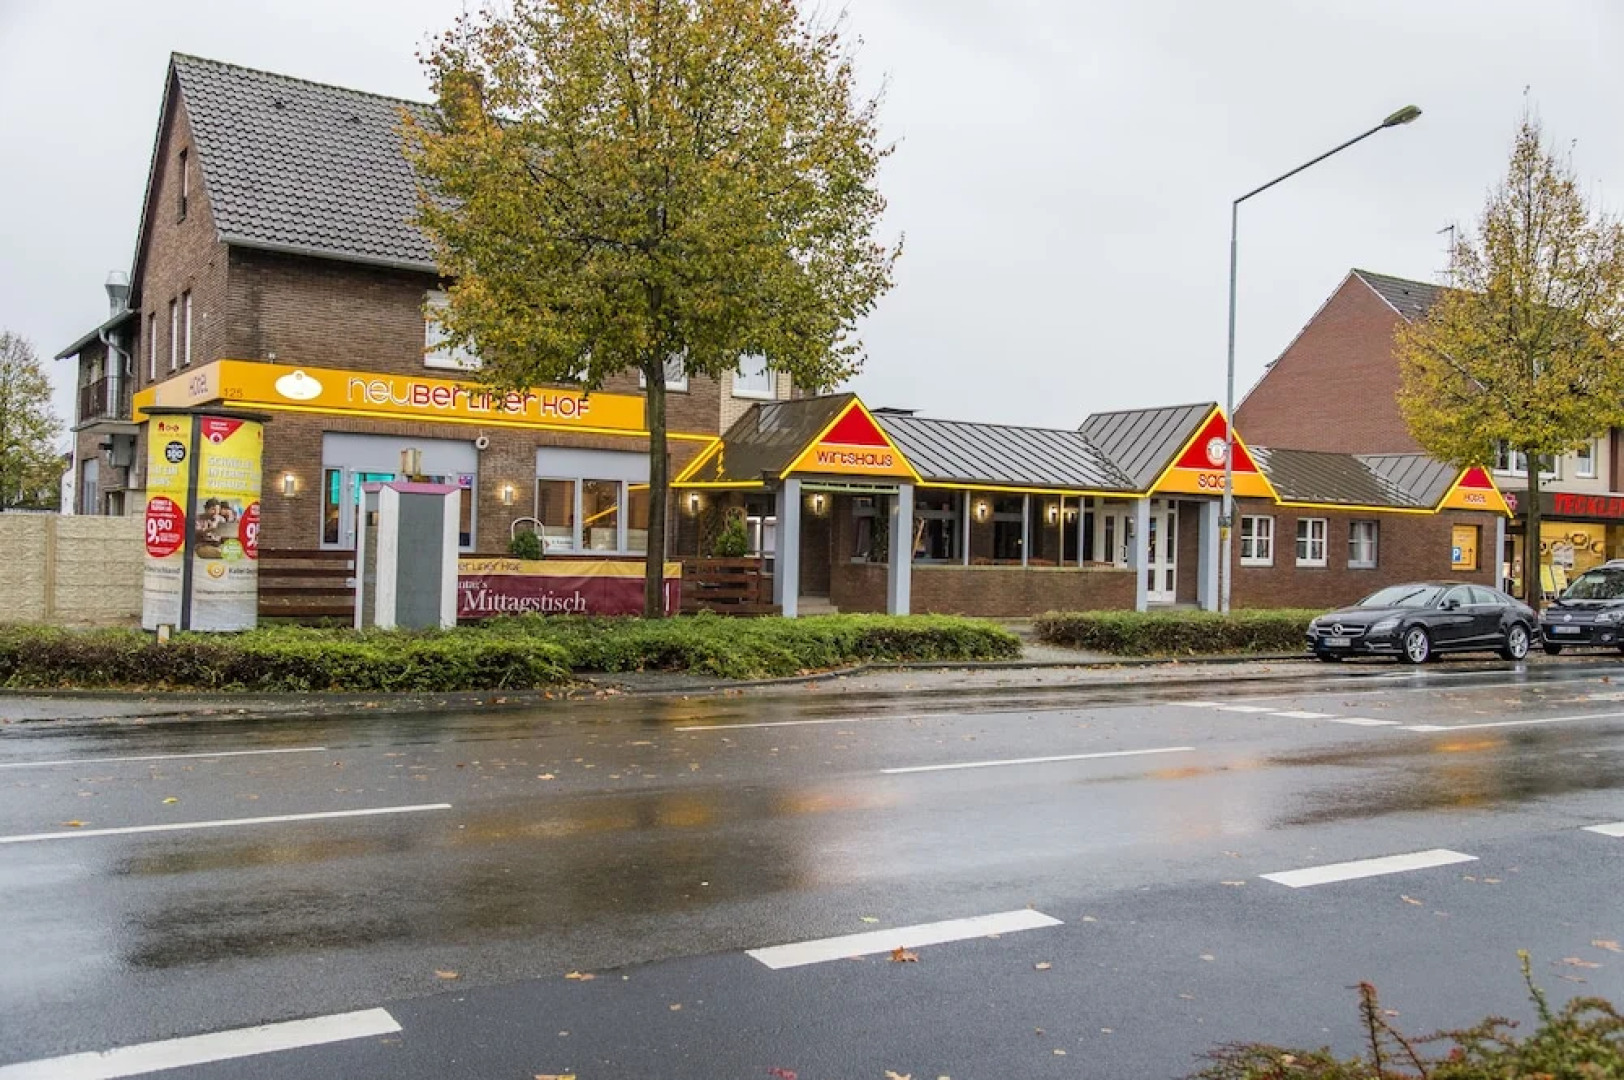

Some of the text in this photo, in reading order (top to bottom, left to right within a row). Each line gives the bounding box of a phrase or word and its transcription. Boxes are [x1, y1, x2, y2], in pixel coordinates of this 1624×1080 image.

[223, 388, 244, 399] 125
[541, 394, 590, 419] HOF
[463, 588, 586, 613] Mittagstisch
